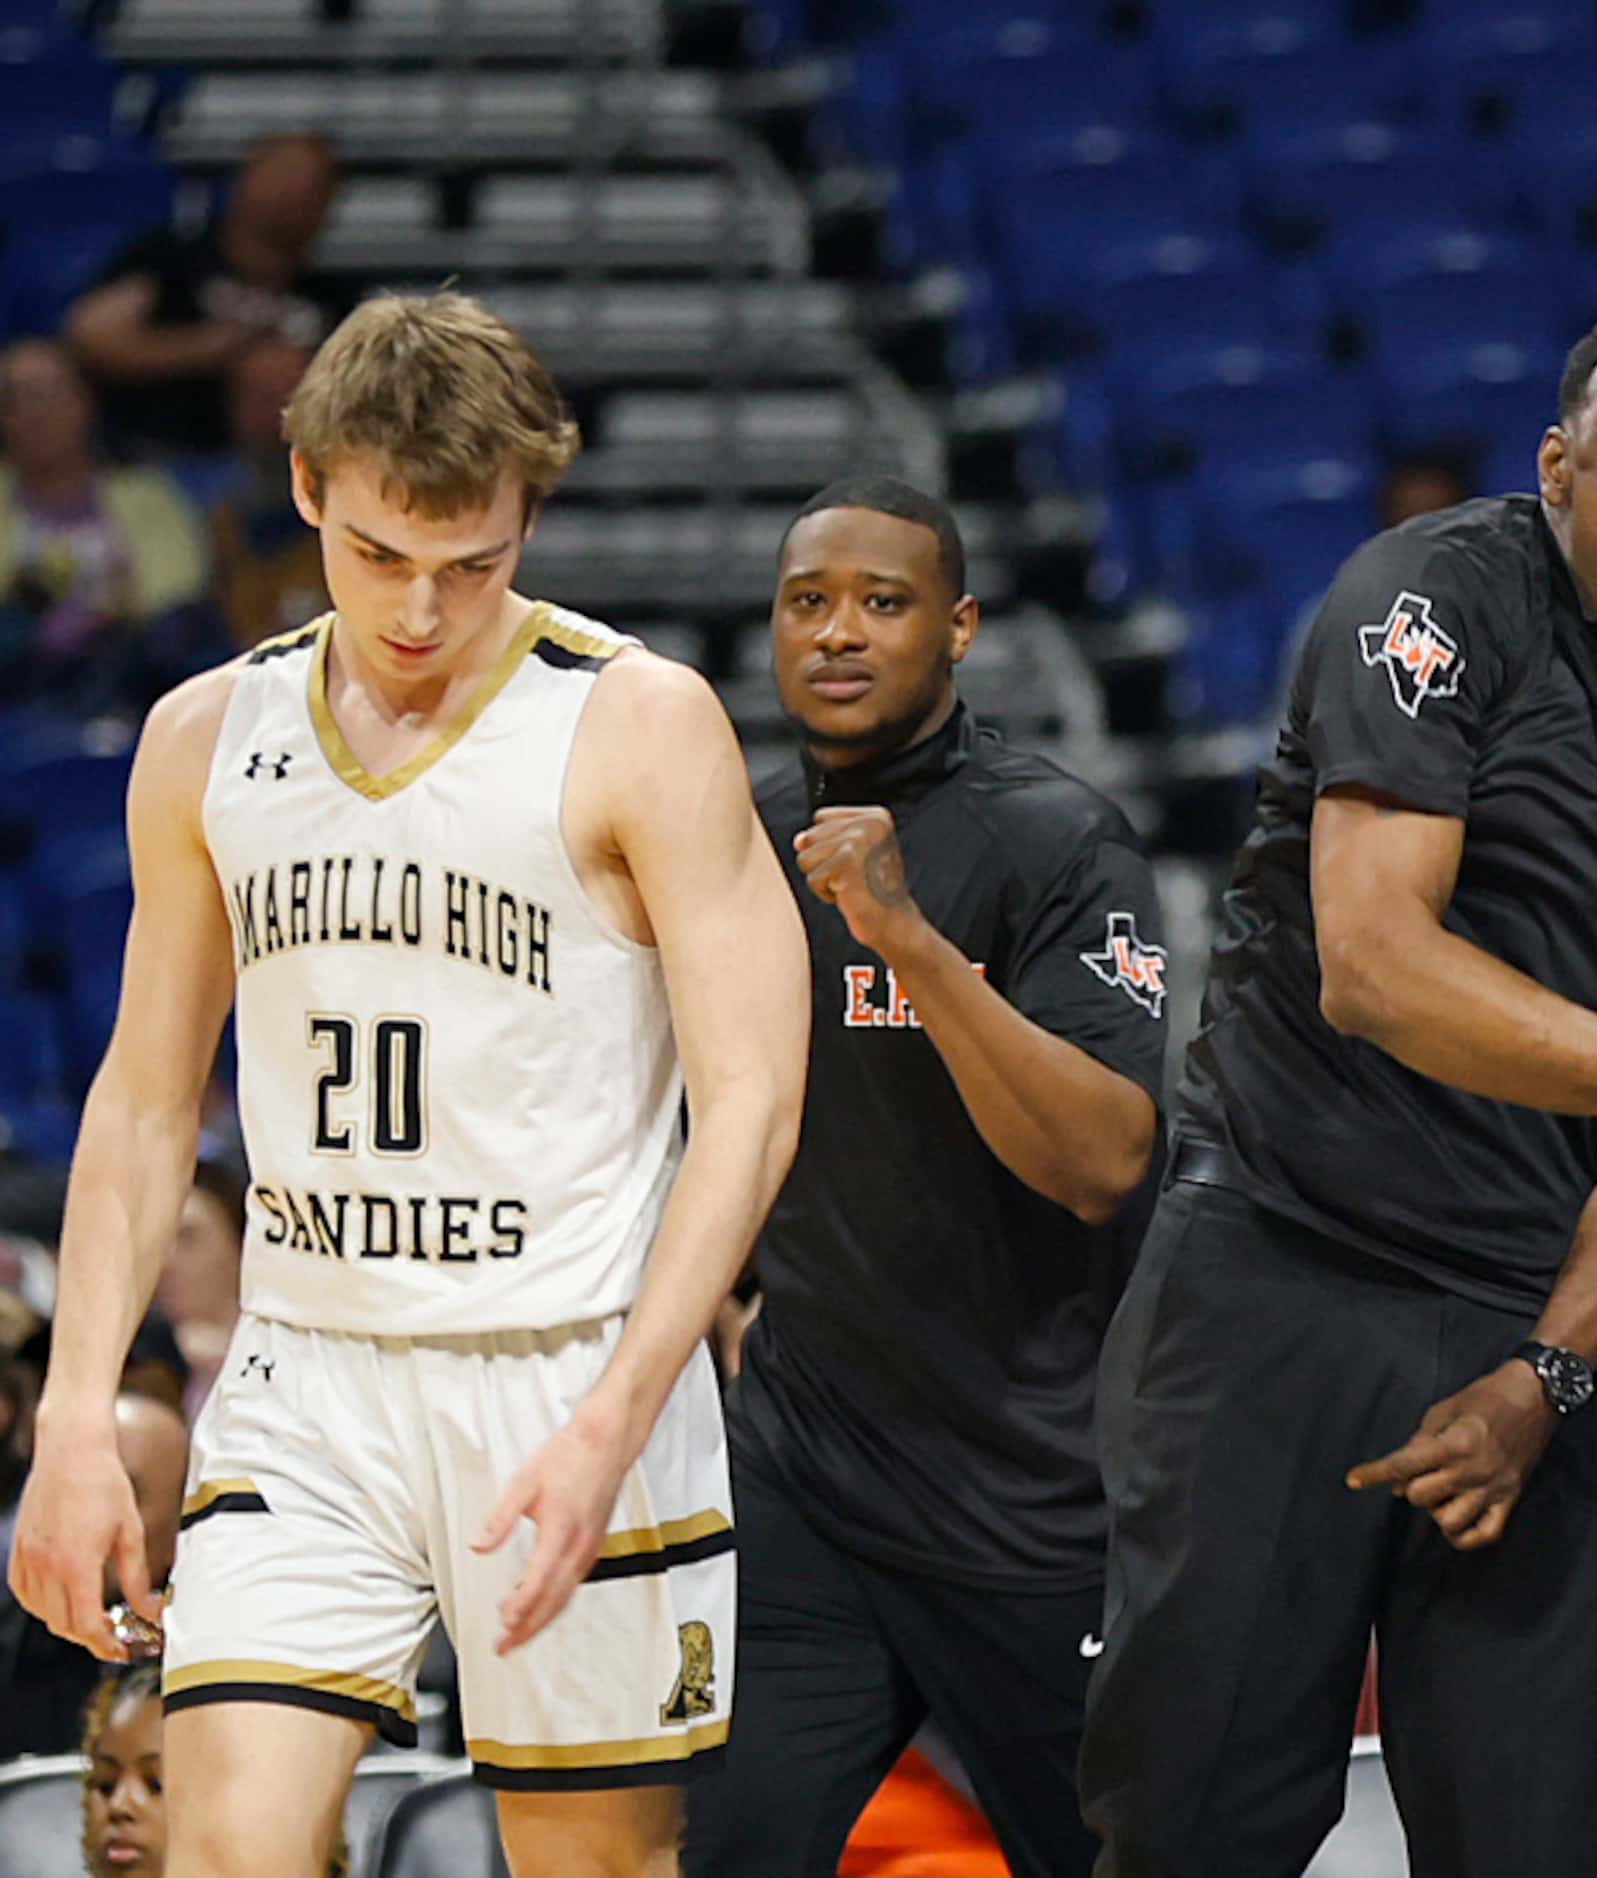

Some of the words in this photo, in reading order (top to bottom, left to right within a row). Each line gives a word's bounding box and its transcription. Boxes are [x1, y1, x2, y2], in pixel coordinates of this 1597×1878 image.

[232, 857, 421, 968] MARILLO
[445, 869, 553, 996] HIGH
[305, 1011, 429, 1159] 20
[252, 1182, 530, 1265] SANDIES
